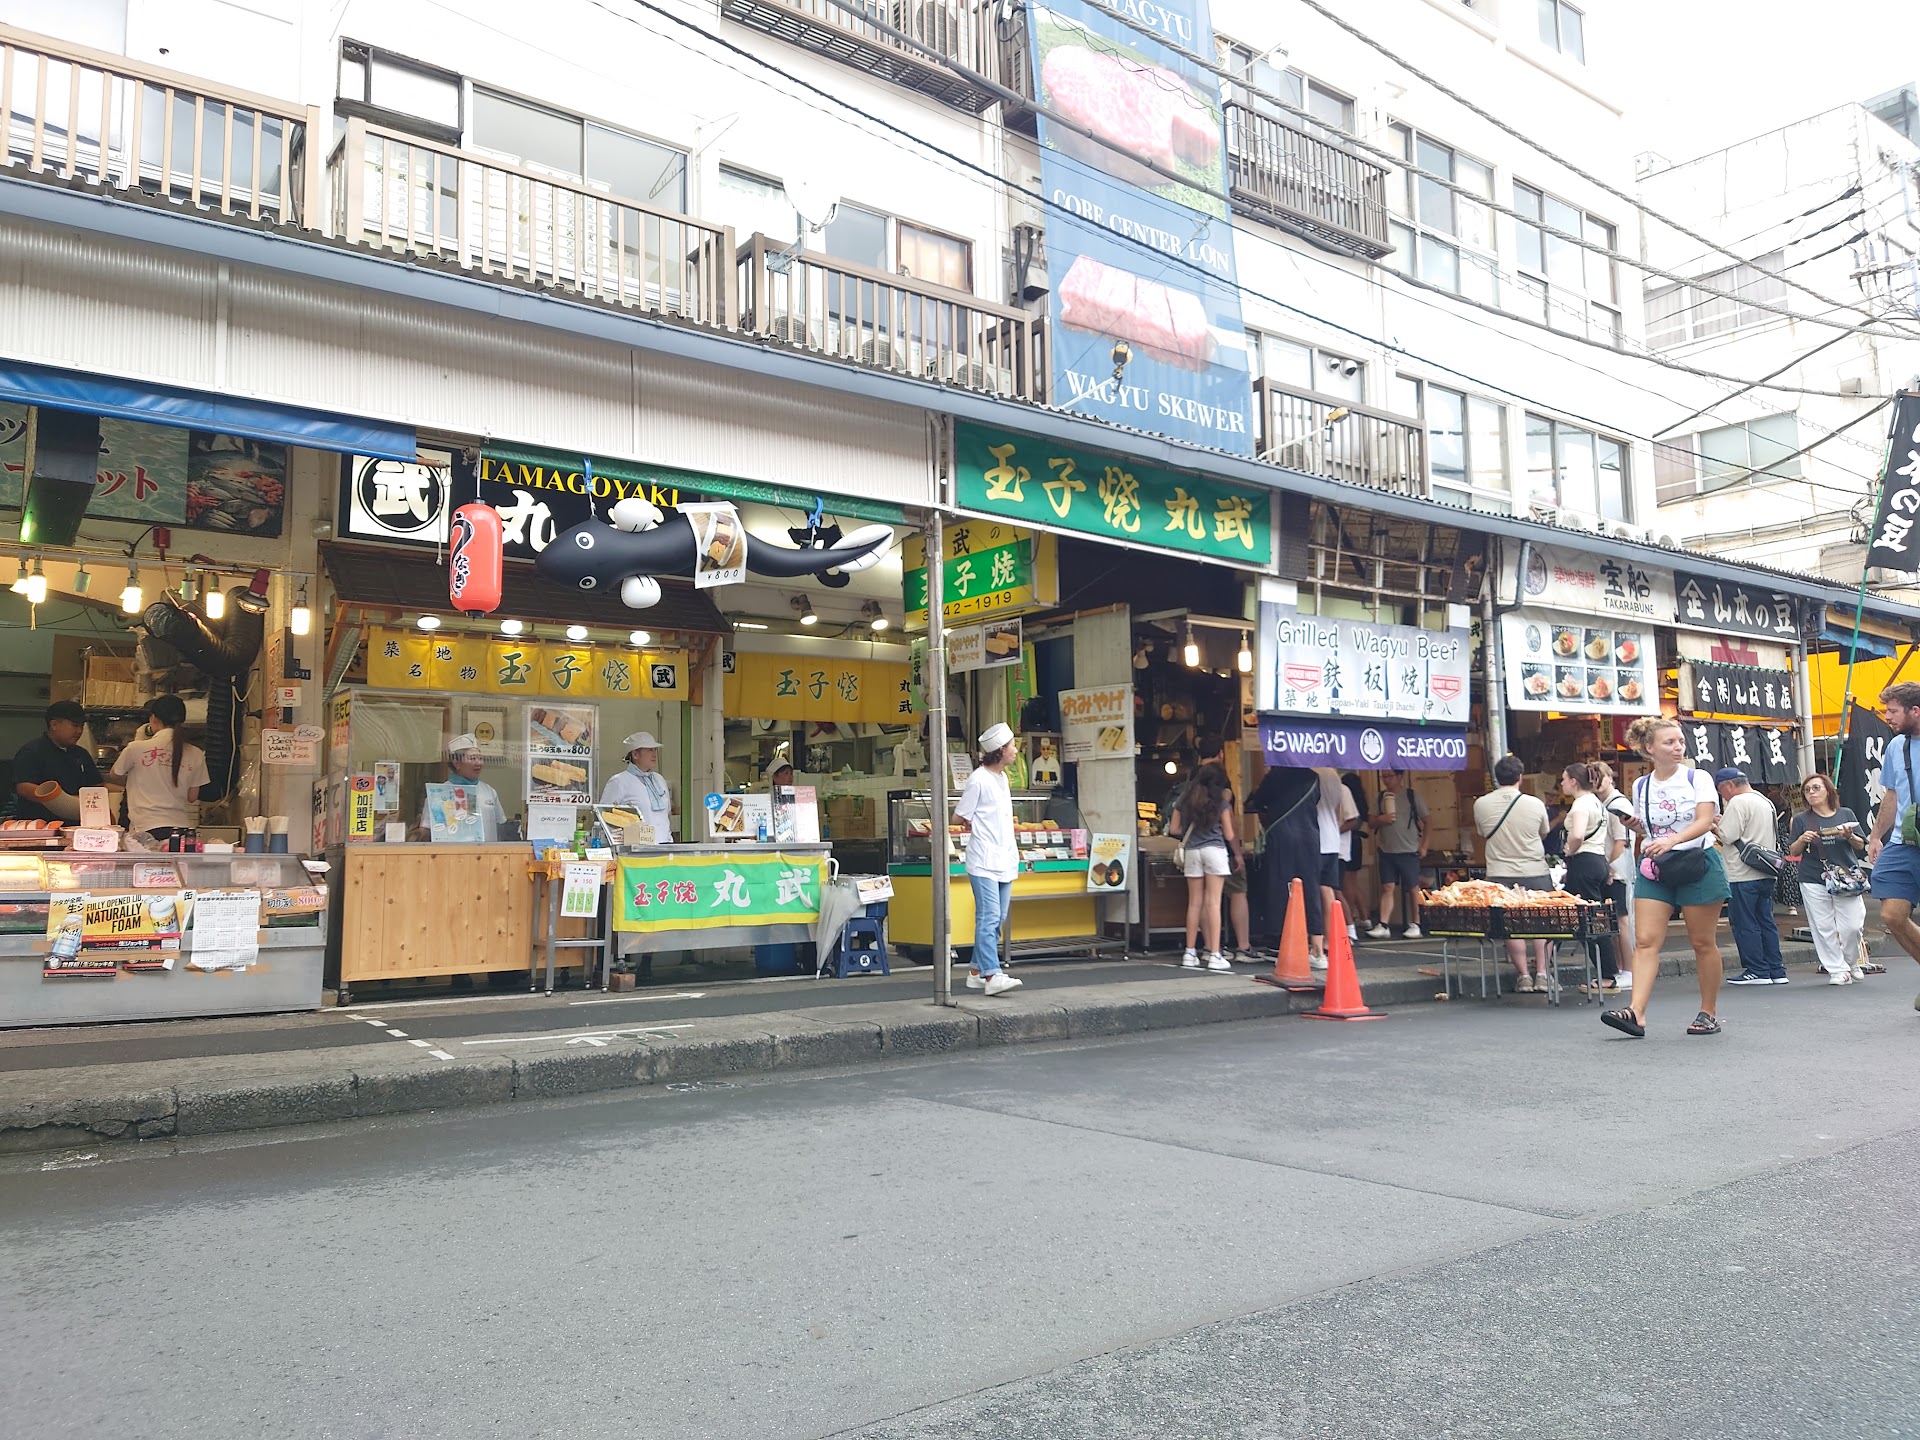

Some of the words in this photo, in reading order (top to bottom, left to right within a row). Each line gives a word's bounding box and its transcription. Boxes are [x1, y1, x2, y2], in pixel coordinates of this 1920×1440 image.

[1110, 214, 1182, 256] CENTER
[1188, 240, 1229, 272] LOIN
[1065, 369, 1149, 411] WAGYU
[1159, 392, 1246, 434] SKEWER
[480, 457, 680, 509] TAMAGOYAKI
[1164, 486, 1254, 550] 丸武
[1600, 560, 1651, 599] 宝船
[922, 591, 1013, 621] 342-1919
[1603, 597, 1655, 615] TAKARABUNE
[1277, 619, 1340, 649] Grilled
[1353, 629, 1409, 658] Wagyu
[1416, 637, 1458, 662] Beef
[1062, 688, 1126, 717] おみやげ
[1397, 736, 1466, 758] SEAFOOD
[356, 794, 369, 832] 加盟店
[86, 900, 105, 912] FULLY
[106, 896, 132, 908] OPENED
[86, 902, 142, 926] NATURALLY
[111, 915, 141, 933] FOAM
